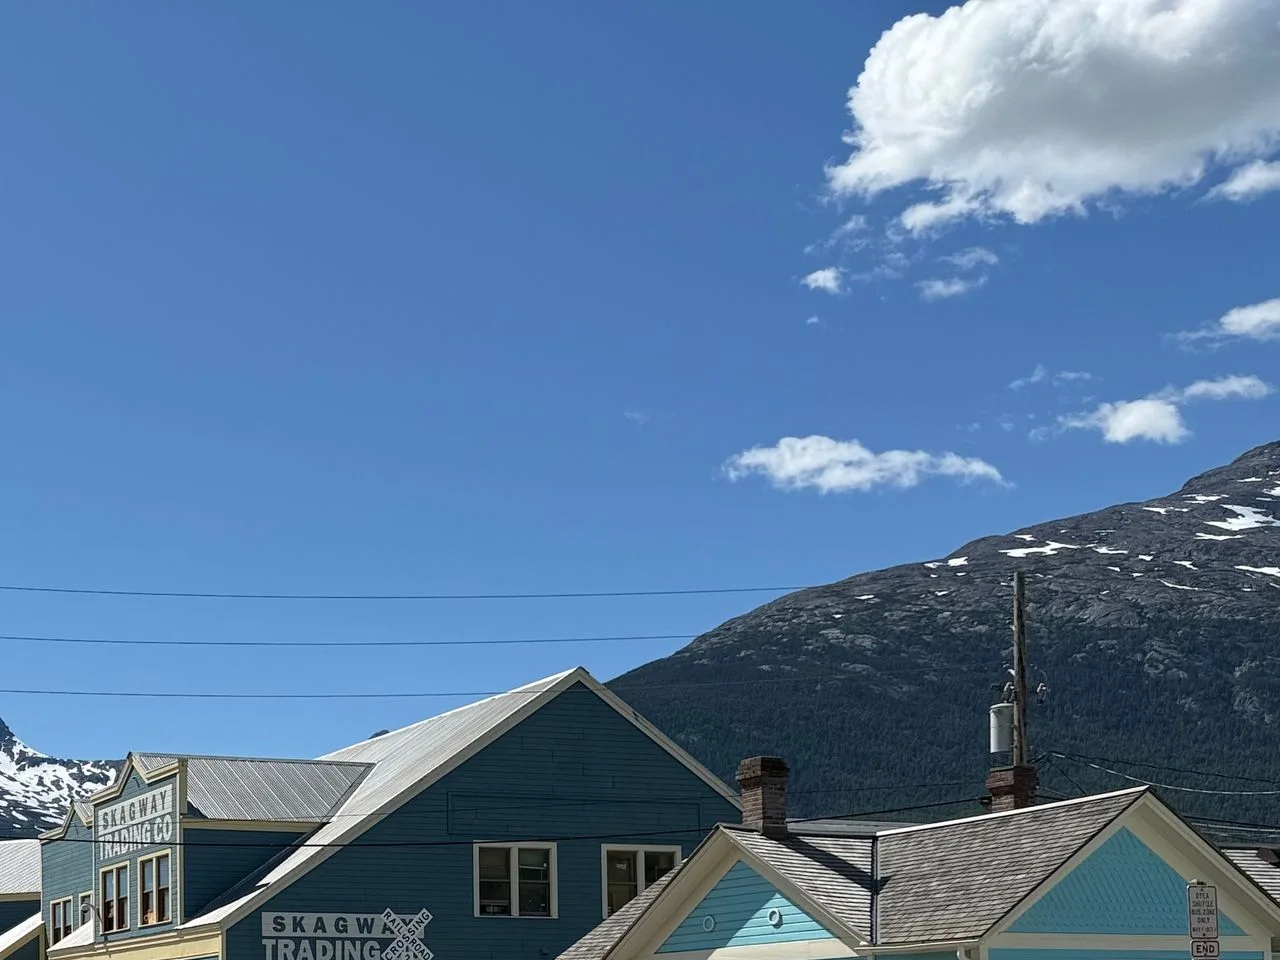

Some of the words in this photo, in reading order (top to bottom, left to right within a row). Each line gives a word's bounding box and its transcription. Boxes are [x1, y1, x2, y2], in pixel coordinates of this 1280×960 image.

[102, 790, 167, 830] SKAGWAY
[99, 822, 151, 860] TRADING
[154, 814, 173, 843] CO
[384, 911, 430, 960] CROSSING
[1196, 944, 1215, 953] END
